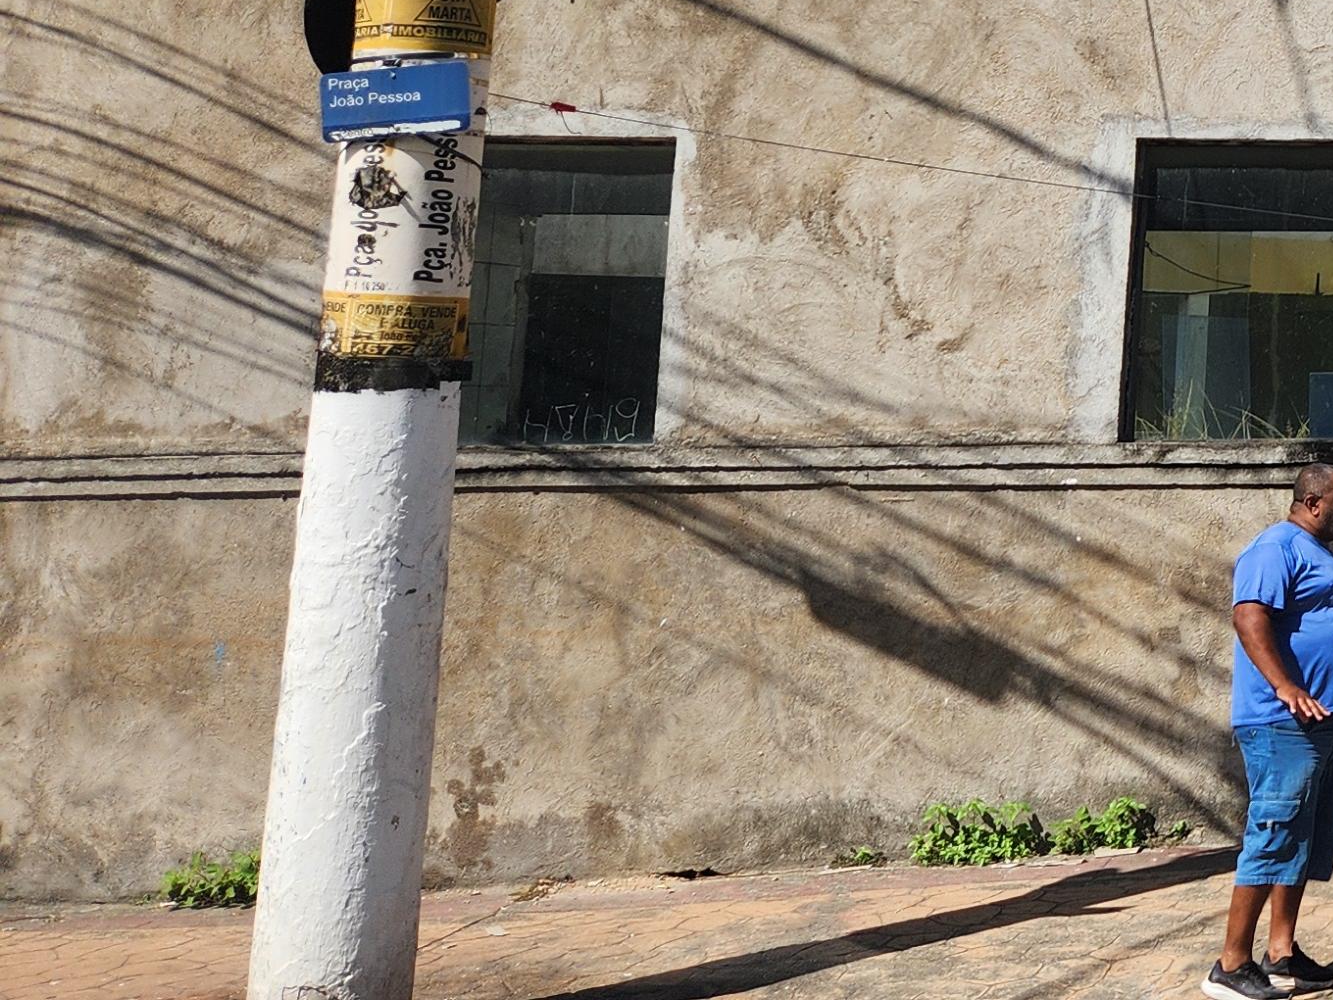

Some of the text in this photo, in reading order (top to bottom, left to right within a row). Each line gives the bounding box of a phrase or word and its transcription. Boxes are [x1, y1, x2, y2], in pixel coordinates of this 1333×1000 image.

[428, 6, 472, 22] MARTA
[328, 78, 369, 92] Praça
[329, 91, 421, 108] João Pessoa
[418, 189, 453, 236] João
[413, 242, 451, 283] Pça.
